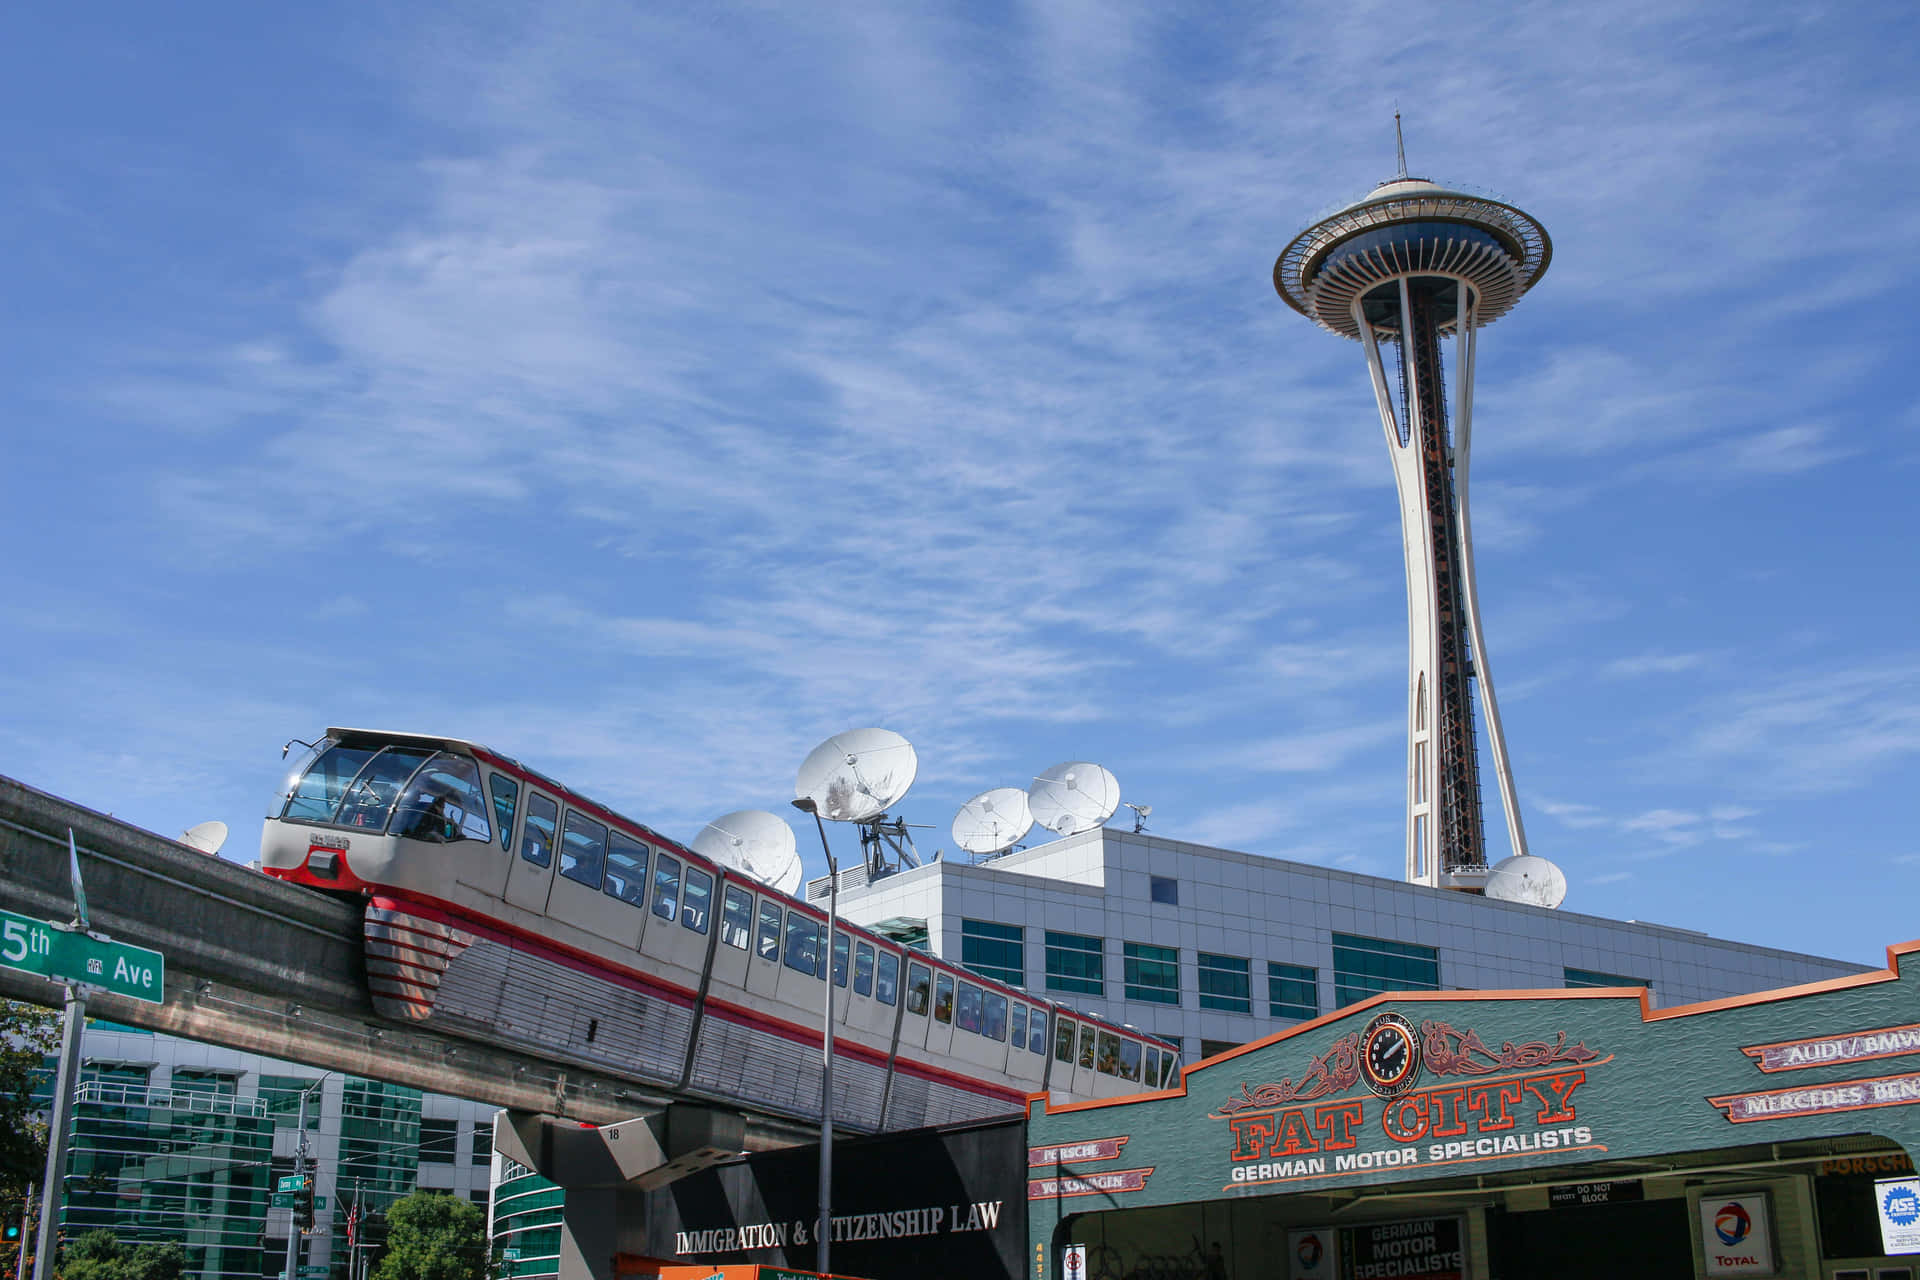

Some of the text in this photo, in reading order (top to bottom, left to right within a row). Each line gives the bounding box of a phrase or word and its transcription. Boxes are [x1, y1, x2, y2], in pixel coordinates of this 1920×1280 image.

[1, 919, 50, 962] 5th
[114, 956, 153, 988] Ave
[1788, 1040, 1844, 1063] AUDI
[1865, 1029, 1920, 1052] BMW
[1747, 1086, 1864, 1114] MERCEDES
[1230, 1070, 1587, 1162] FAT CITY
[608, 1128, 619, 1140] 18
[1231, 1126, 1593, 1183] GERMAN MOTOR SPECIALISTS
[1576, 1185, 1590, 1195] DO
[1593, 1183, 1612, 1193] NOT
[1582, 1193, 1609, 1203] BLOCK
[1889, 1197, 1915, 1213] ASE
[675, 1222, 787, 1255] IMMIGRATION
[792, 1220, 809, 1246] &
[950, 1200, 1003, 1233] LAW
[1371, 1221, 1435, 1242] GERMAN
[1373, 1236, 1437, 1260] MOTOR
[1715, 1255, 1760, 1267] TOTAL
[1356, 1251, 1465, 1280] SPECIALISTS
